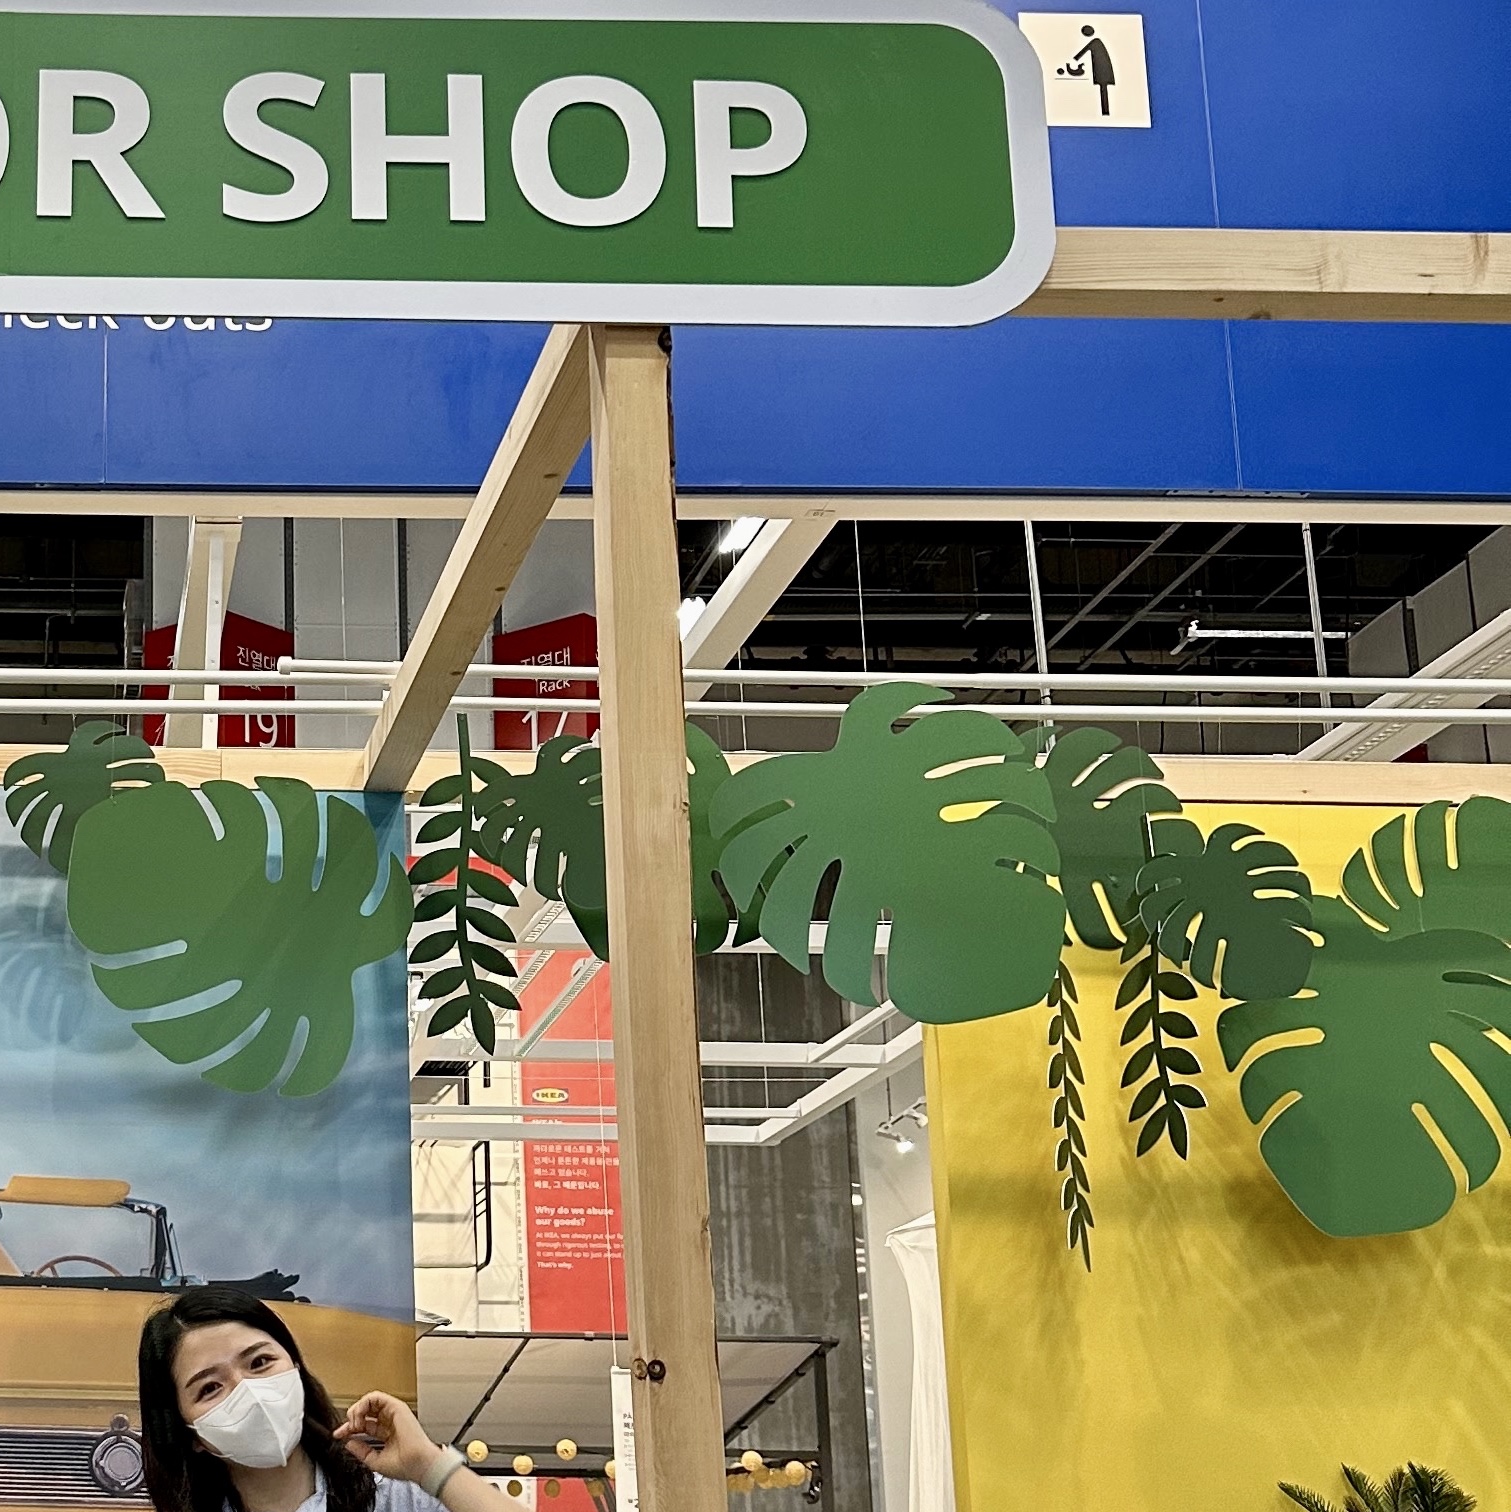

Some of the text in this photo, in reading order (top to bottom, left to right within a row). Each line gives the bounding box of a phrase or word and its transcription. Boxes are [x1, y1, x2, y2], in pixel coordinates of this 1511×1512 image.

[222, 71, 809, 229] SHOP
[535, 1091, 565, 1099] IKEA
[534, 1205, 556, 1217] Why
[557, 1206, 570, 1215] do
[571, 1207, 585, 1215] we
[535, 1217, 586, 1228] our goods?
